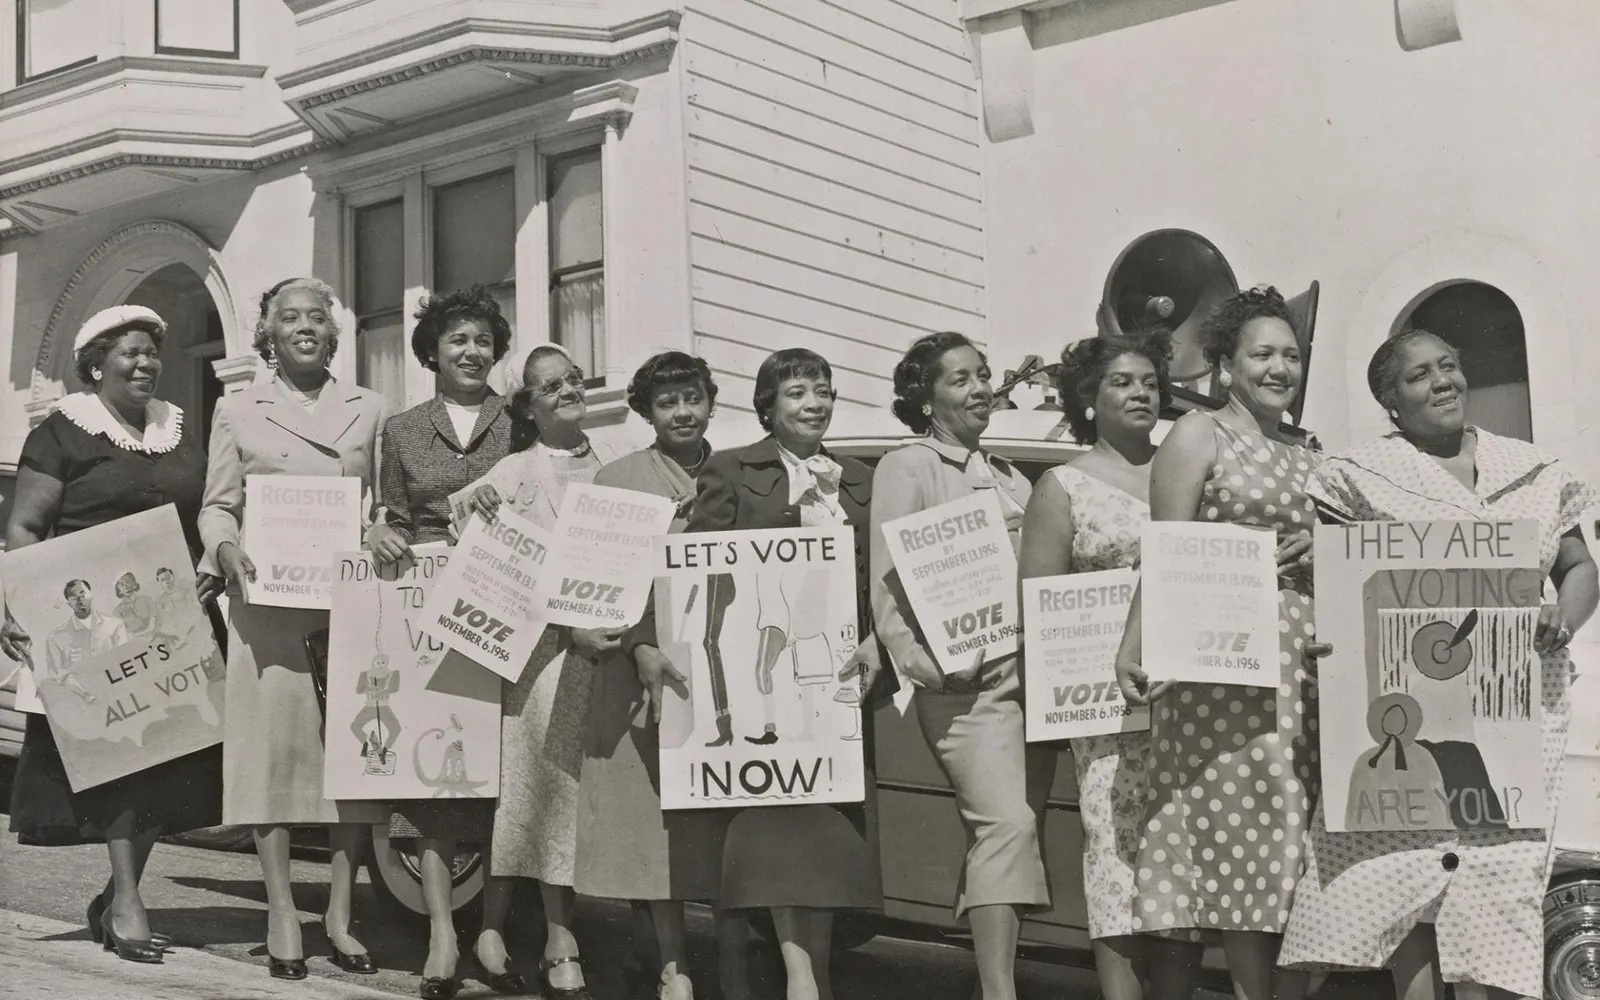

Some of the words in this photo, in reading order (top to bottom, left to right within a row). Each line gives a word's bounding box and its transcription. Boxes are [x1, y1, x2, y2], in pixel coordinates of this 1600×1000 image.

[261, 484, 347, 507] REGISTER
[574, 493, 660, 525] REGISTER
[898, 508, 990, 554] REGISTER
[1340, 522, 1432, 559] THEY
[1443, 522, 1514, 559] ARE
[665, 541, 738, 569] LET'S
[750, 537, 836, 564] VOTE
[942, 544, 955, 556] BY
[469, 545, 526, 587] SEPTEMBER
[912, 551, 968, 581] SEPTEMBER
[263, 583, 311, 594] NOVEMBER
[397, 586, 424, 610] TO
[560, 577, 625, 604] VOTE
[1038, 583, 1133, 613] REGISTER
[1388, 567, 1531, 609] VOTING
[452, 597, 516, 643] VOTE
[546, 598, 594, 616] NOVEMBER
[942, 602, 1003, 640] VOTE
[1079, 613, 1093, 622] BY
[437, 614, 482, 647] NOVEMBER
[946, 634, 990, 657] NOVEMBER
[1041, 622, 1102, 642] SEPTEMBER
[1195, 630, 1250, 653] OTE
[105, 643, 170, 685] LET'S
[1053, 680, 1122, 707] VOTE
[105, 693, 150, 728] ALL
[1045, 708, 1097, 725] NOVEMBER
[1355, 788, 1427, 826] ARE
